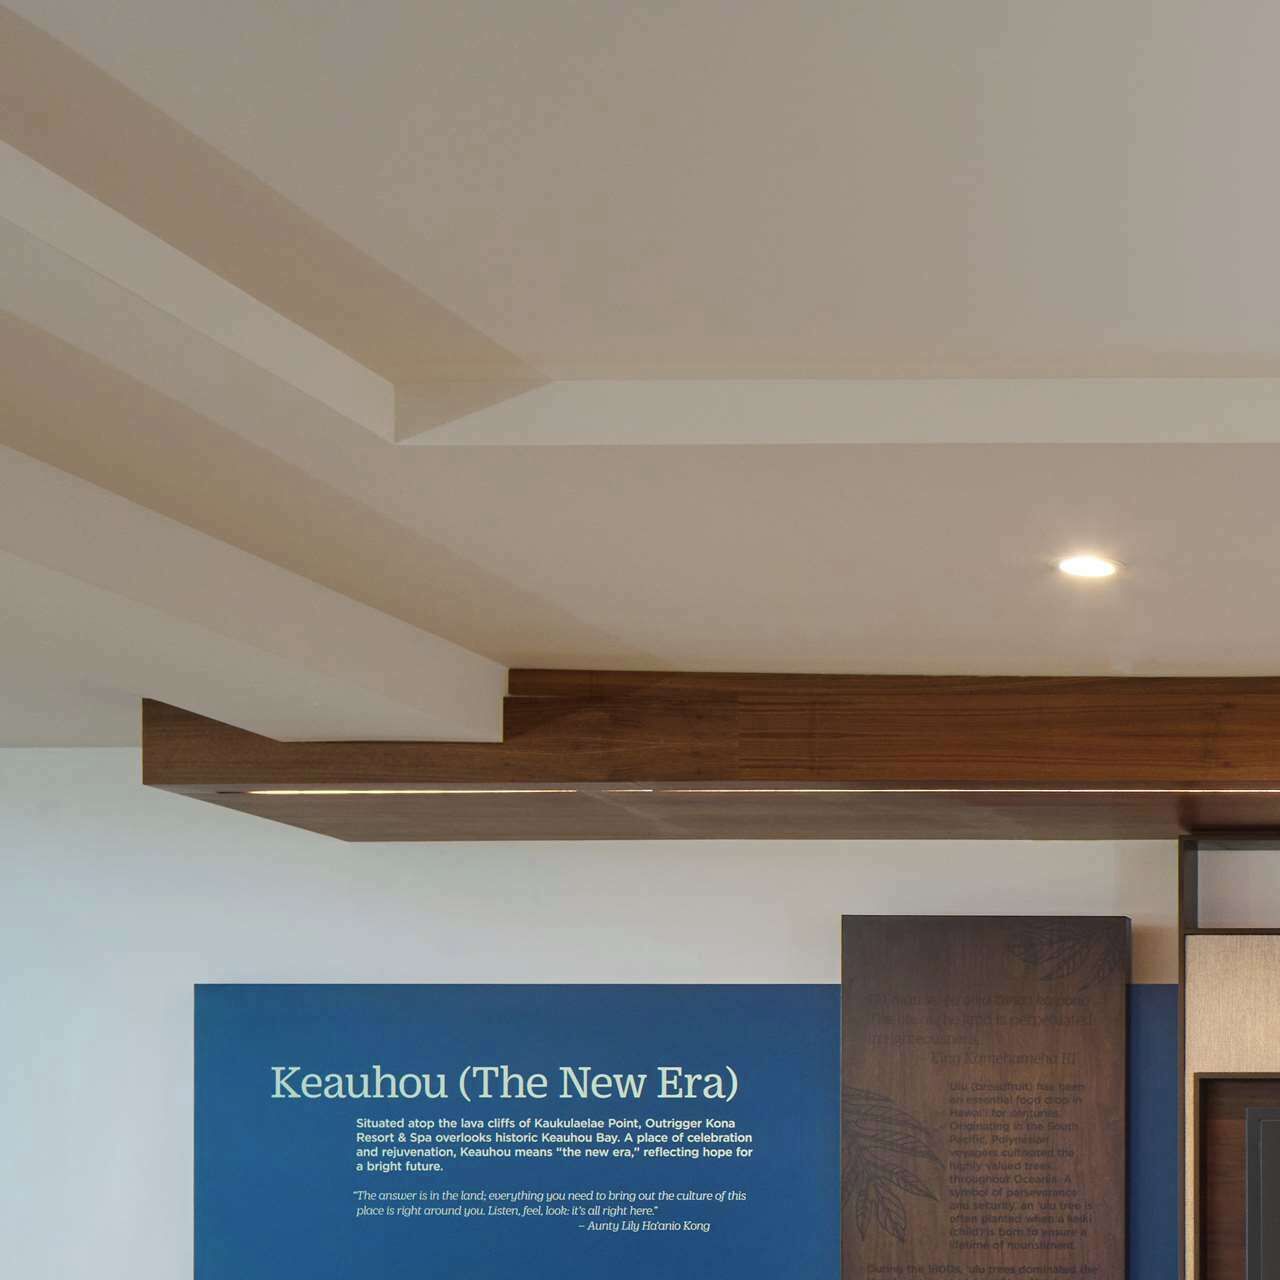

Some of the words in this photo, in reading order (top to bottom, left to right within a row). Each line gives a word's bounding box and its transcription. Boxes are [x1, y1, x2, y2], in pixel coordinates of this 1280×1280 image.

[271, 1064, 449, 1099] Keauhou
[459, 1064, 548, 1102] (The
[559, 1066, 648, 1099] New
[657, 1065, 738, 1102] Era)
[356, 1117, 405, 1128] Situated
[407, 1118, 435, 1130] atop
[438, 1118, 458, 1128] the
[461, 1118, 484, 1128] lava
[487, 1117, 516, 1128] cliffs
[518, 1117, 532, 1128] of
[534, 1118, 607, 1128] Kaukulaelae
[608, 1118, 642, 1130] Point,
[645, 1118, 703, 1131] Outrigger
[706, 1118, 736, 1129] Kona
[356, 1132, 395, 1143] Resort
[398, 1132, 407, 1143] &
[410, 1132, 432, 1144] Spa
[435, 1132, 493, 1143] overlooks
[495, 1132, 538, 1143] historic
[541, 1132, 593, 1143] Keauhou
[596, 1132, 620, 1145] Bay.
[624, 1132, 634, 1143] A
[637, 1132, 669, 1144] place
[671, 1132, 684, 1143] of
[687, 1132, 753, 1143] celebration
[356, 1146, 378, 1157] and
[382, 1146, 457, 1159] rejuvenation,
[460, 1146, 511, 1157] Keauhou
[514, 1148, 553, 1157] means
[585, 1148, 610, 1157] new
[643, 1146, 701, 1159] reflecting
[702, 1147, 733, 1159] hope
[736, 1146, 754, 1157] for
[356, 1163, 363, 1171] a
[367, 1160, 402, 1173] bright
[405, 1161, 444, 1171] future.
[378, 1192, 418, 1201] answer
[419, 1191, 428, 1201] is
[429, 1190, 440, 1200] in
[442, 1190, 459, 1201] the
[488, 1190, 544, 1202] everything
[546, 1192, 566, 1202] you
[567, 1190, 594, 1201] need
[595, 1192, 607, 1201] to
[608, 1190, 637, 1202] bring
[638, 1192, 656, 1201] out
[658, 1190, 675, 1201] the
[676, 1190, 714, 1201] culture
[714, 1190, 727, 1202] of
[727, 1190, 747, 1201] this
[356, 1205, 385, 1217] place
[386, 1206, 395, 1215] is
[396, 1205, 423, 1217] right
[423, 1205, 463, 1216] around
[463, 1207, 486, 1218] you.
[488, 1205, 521, 1216] Listen,
[521, 1205, 544, 1217] feel,
[587, 1205, 601, 1216] all
[601, 1205, 628, 1217] right
[586, 1221, 620, 1233] Aunty
[621, 1220, 640, 1233] Lily
[682, 1220, 711, 1233] Kong
